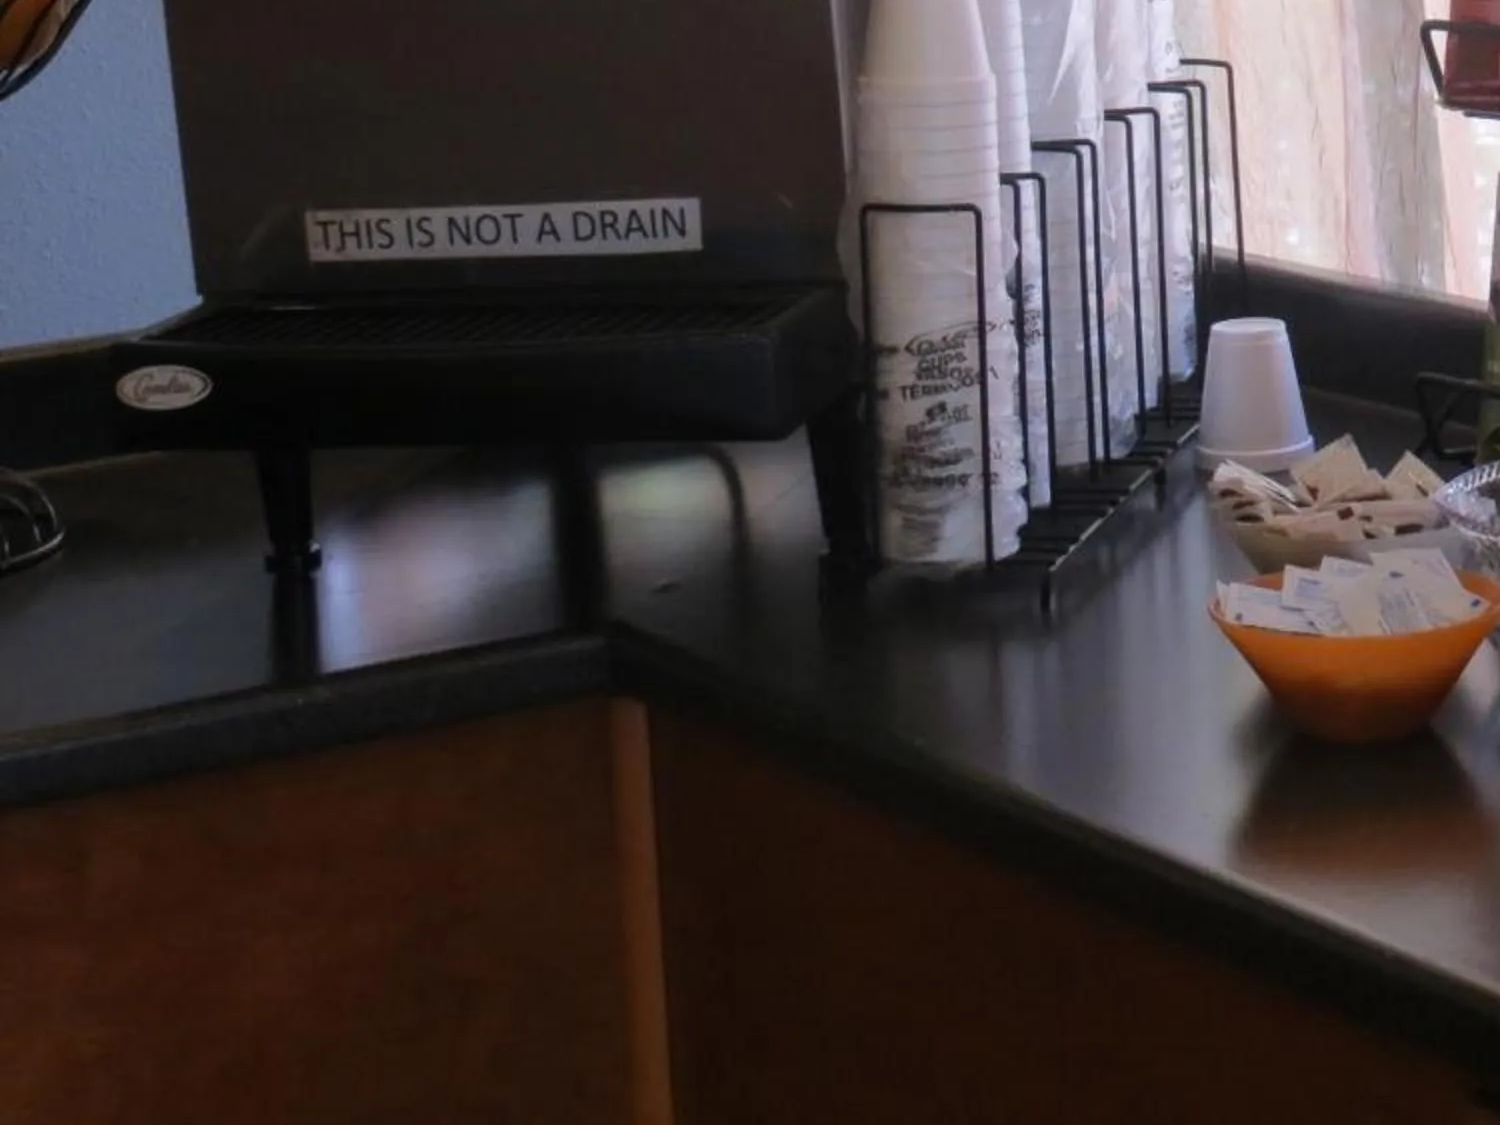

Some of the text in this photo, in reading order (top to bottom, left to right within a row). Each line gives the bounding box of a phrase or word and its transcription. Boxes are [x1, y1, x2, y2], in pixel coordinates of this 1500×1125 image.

[315, 207, 687, 252] THIS IS NOT A DRAIN
